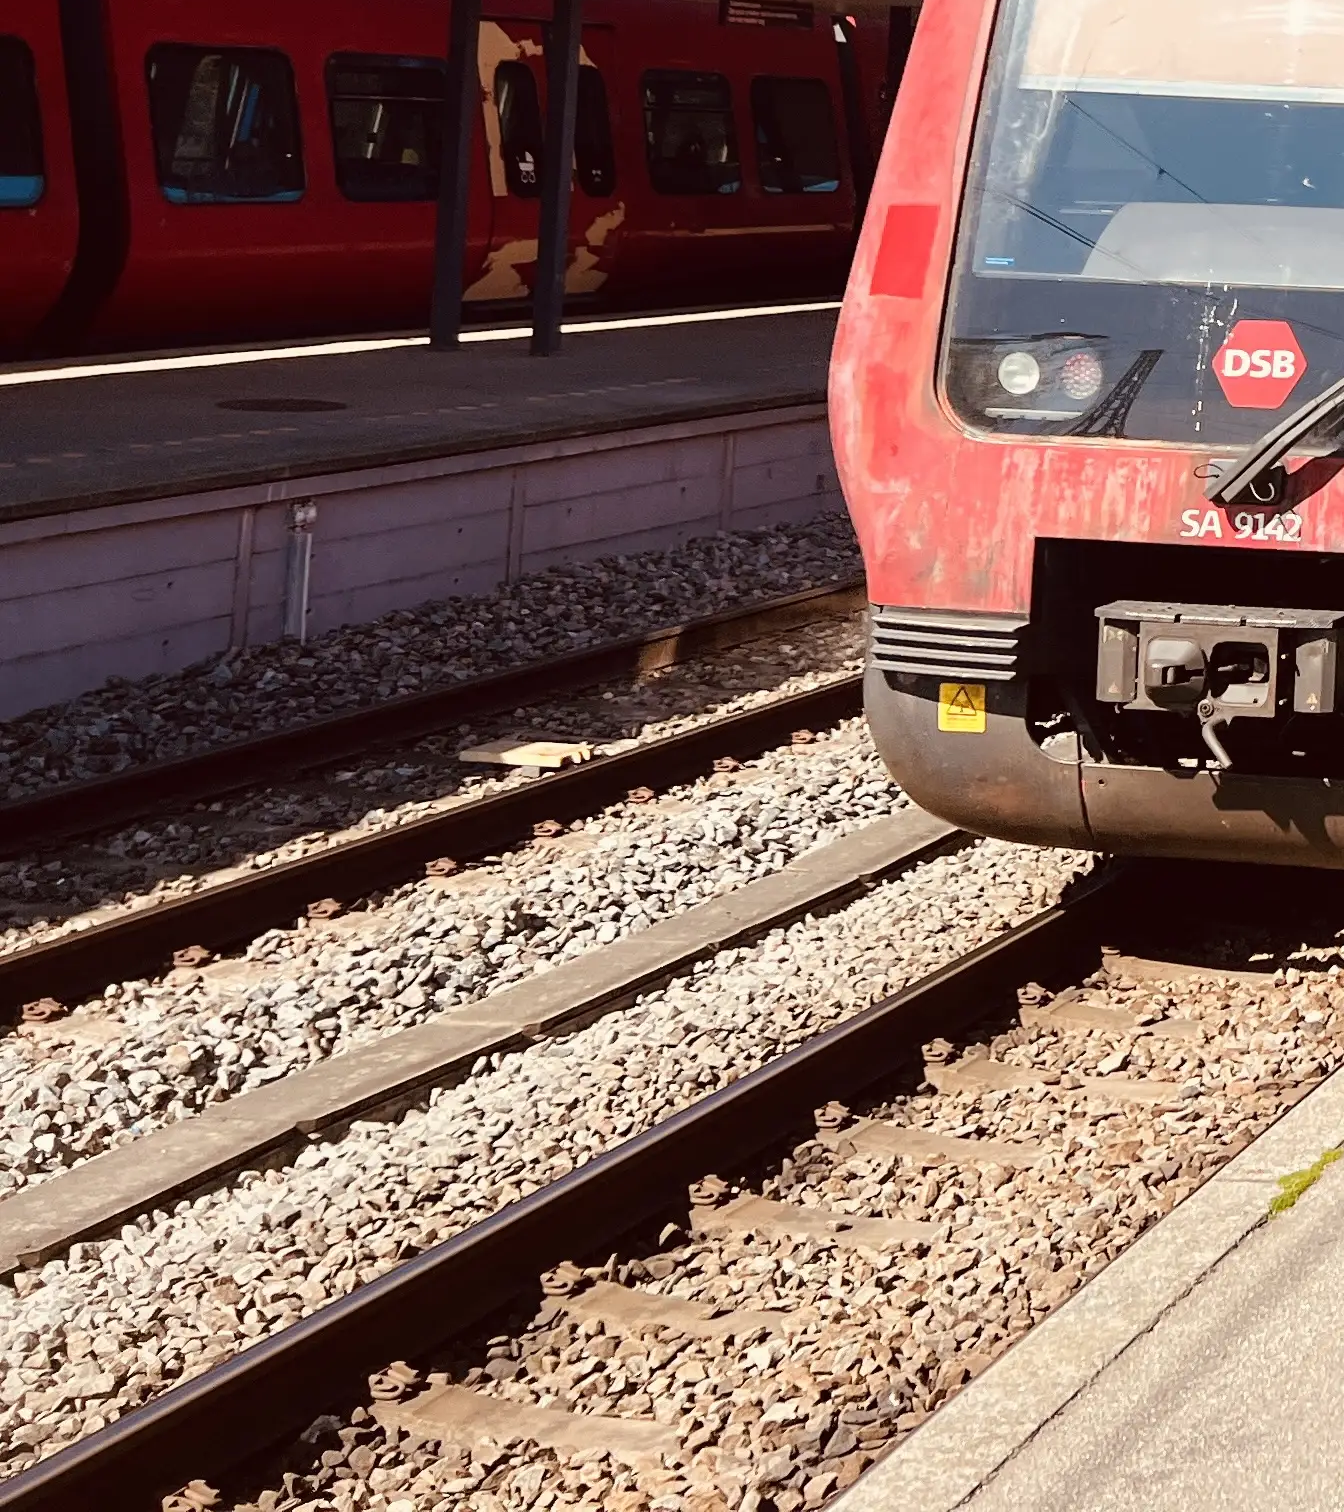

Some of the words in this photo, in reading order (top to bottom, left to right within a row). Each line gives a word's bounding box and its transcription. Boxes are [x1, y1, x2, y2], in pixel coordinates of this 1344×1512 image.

[1222, 348, 1297, 379] DSB
[1179, 508, 1223, 539] SA
[1233, 510, 1303, 543] 9142
